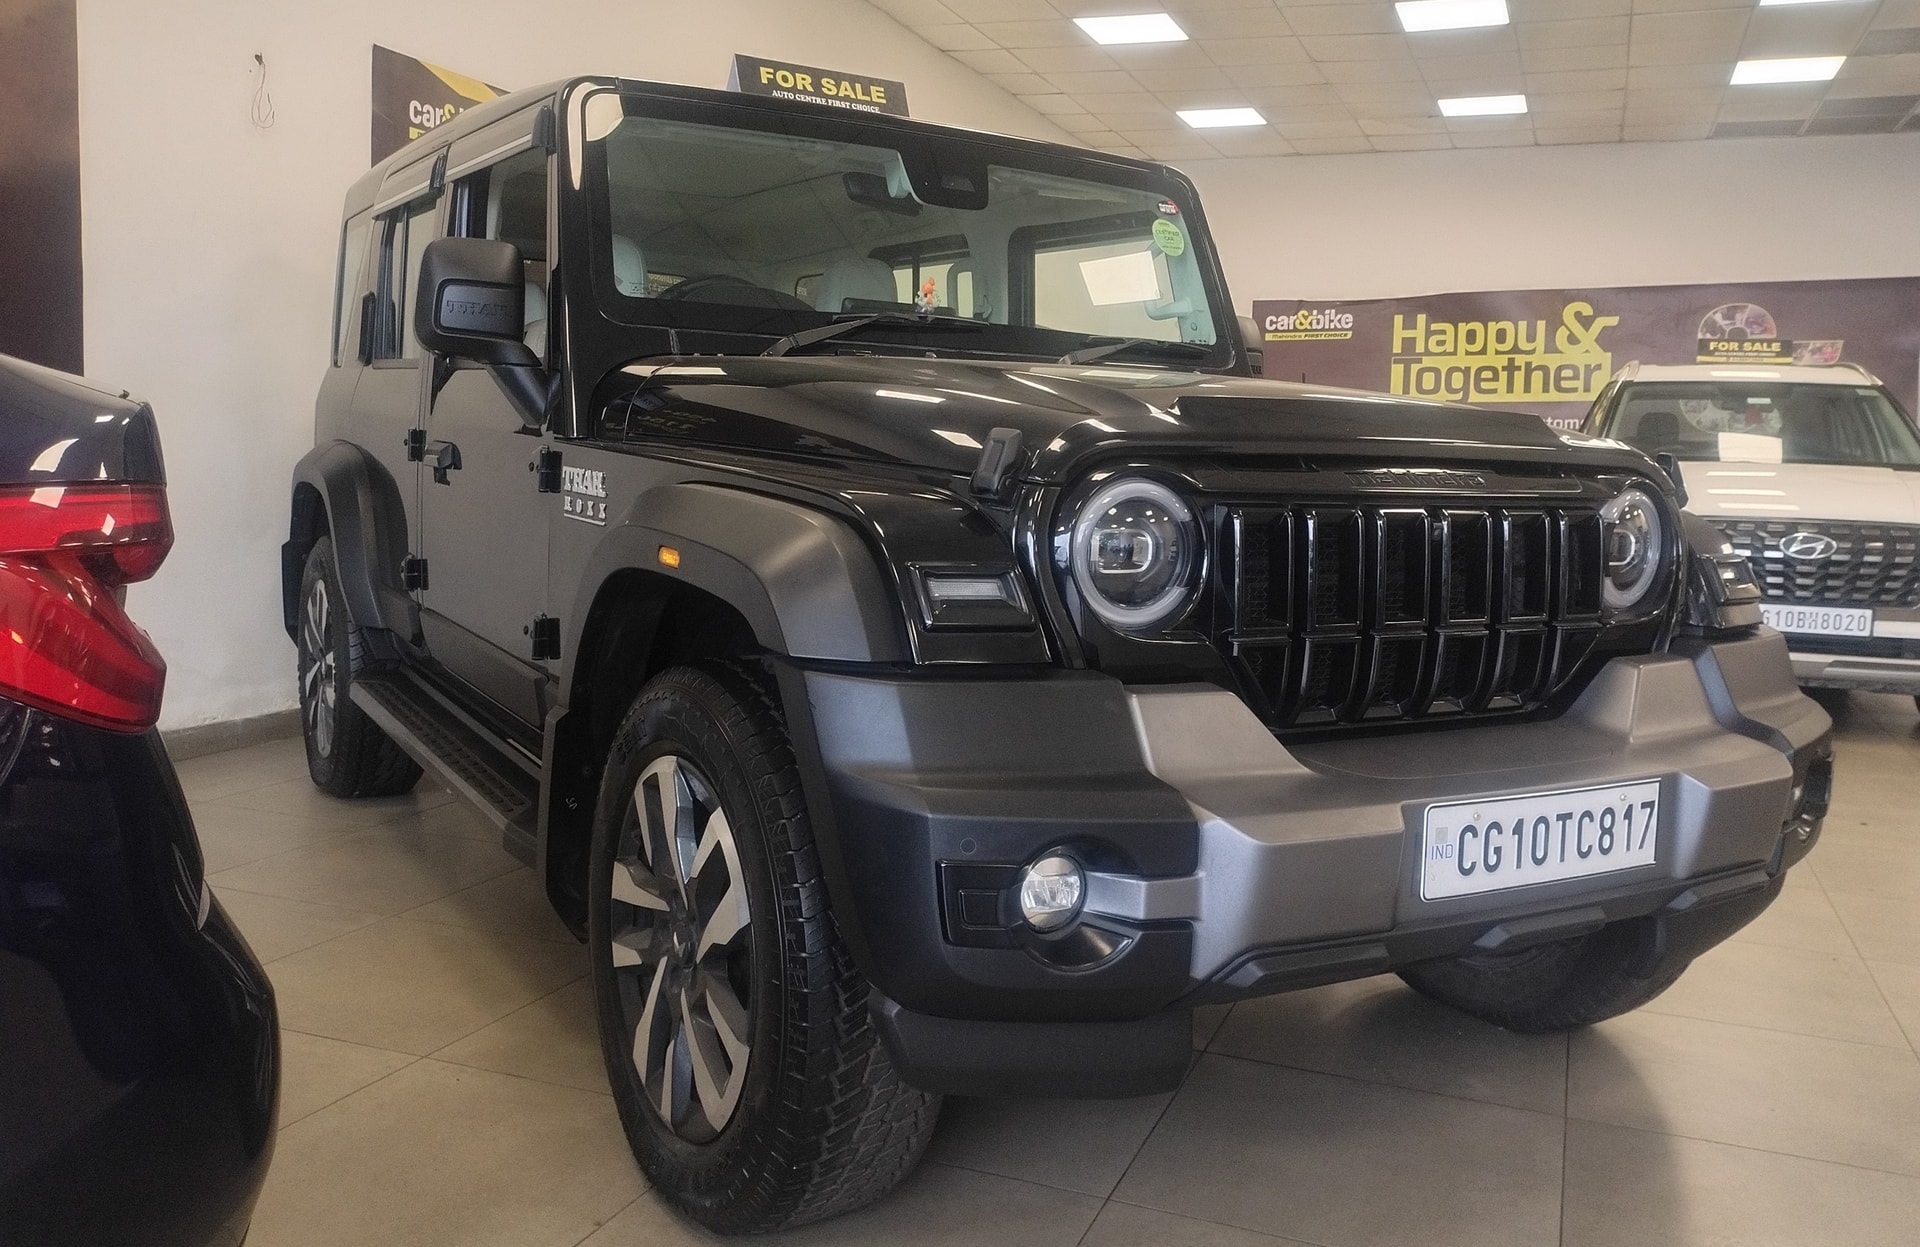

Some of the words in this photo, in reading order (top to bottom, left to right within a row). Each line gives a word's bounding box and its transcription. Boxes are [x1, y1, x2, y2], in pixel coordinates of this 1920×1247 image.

[759, 66, 814, 92] FOR
[821, 77, 887, 104] SALE
[772, 90, 795, 100] AUTO
[795, 93, 827, 105] CENTRE
[828, 99, 851, 109] FIRST
[851, 103, 881, 113] CHOICE
[1265, 309, 1353, 330] car&bike
[1392, 313, 1546, 356] Happy
[1555, 301, 1619, 353] &
[1709, 341, 1739, 351] FOR
[1743, 341, 1782, 352] SALE
[1392, 356, 1602, 402] Together
[1431, 843, 1454, 861] IND
[1457, 800, 1656, 877] CG10TC817
